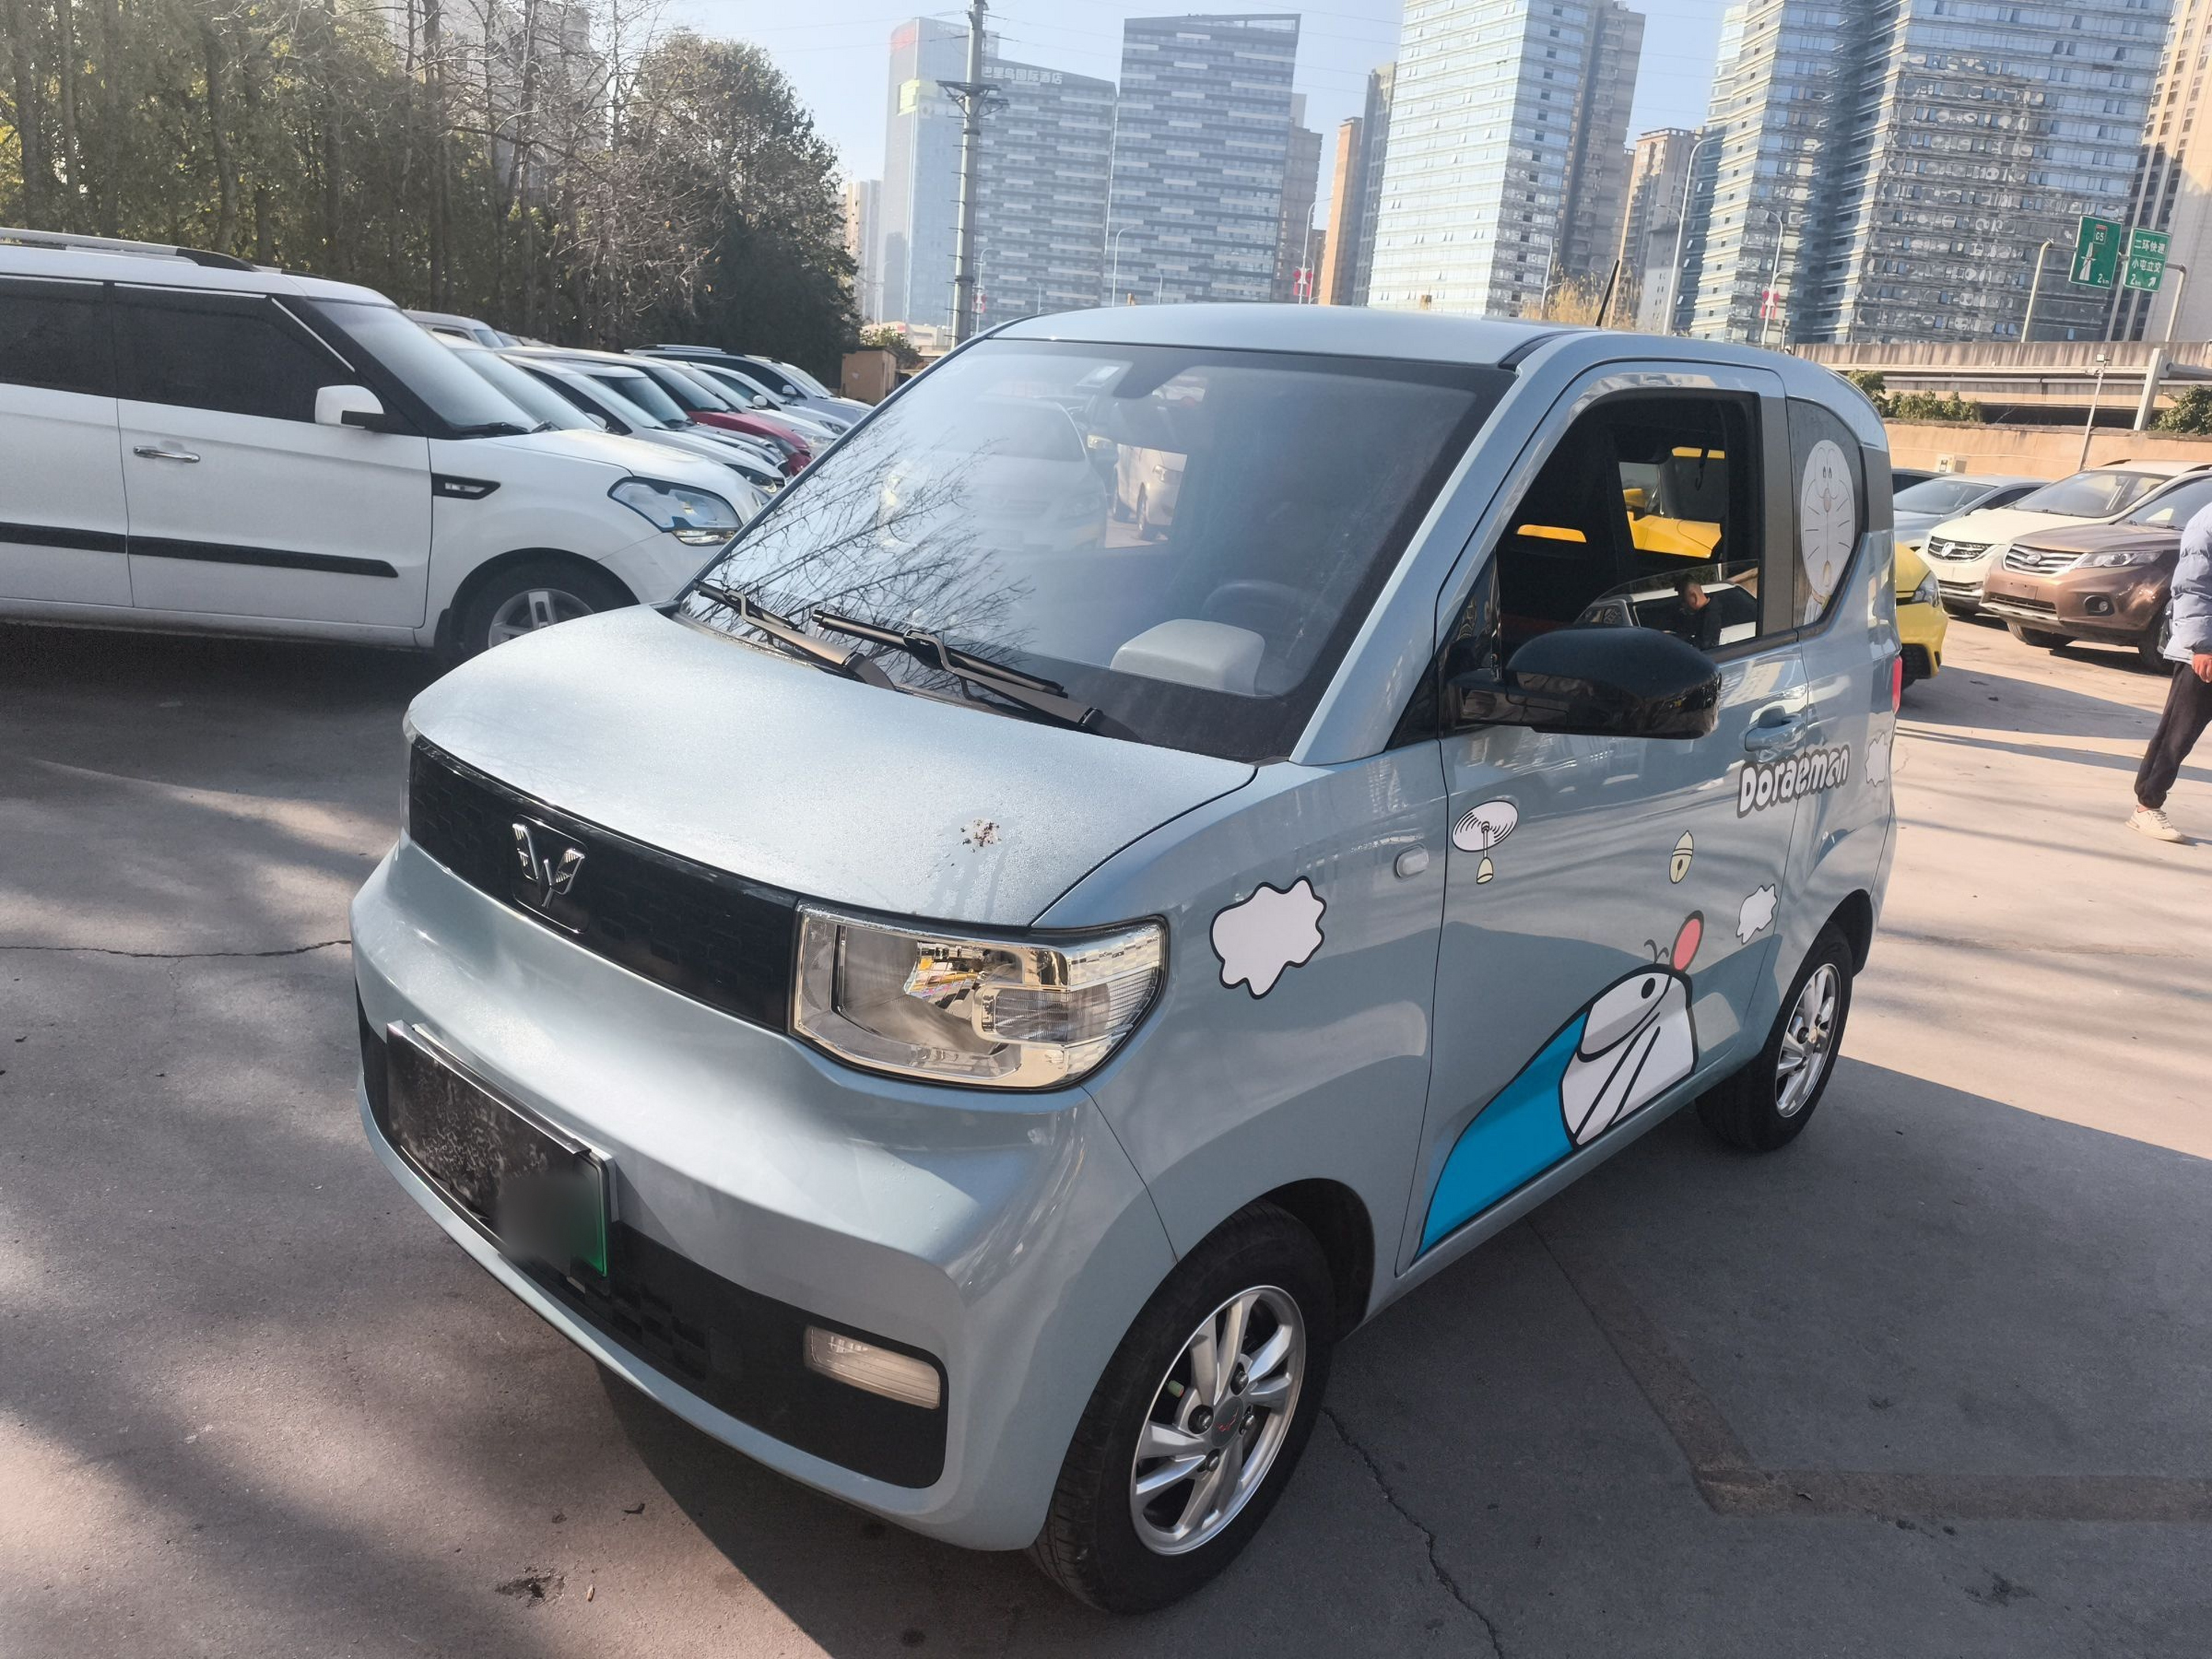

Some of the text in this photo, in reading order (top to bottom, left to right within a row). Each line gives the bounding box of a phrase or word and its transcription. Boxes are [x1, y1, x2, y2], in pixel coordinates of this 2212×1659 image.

[2095, 231, 2105, 241] G5
[2134, 238, 2166, 254] 二环快速
[2131, 257, 2162, 274] 小屯立交
[1737, 745, 1850, 817] Doraemon
